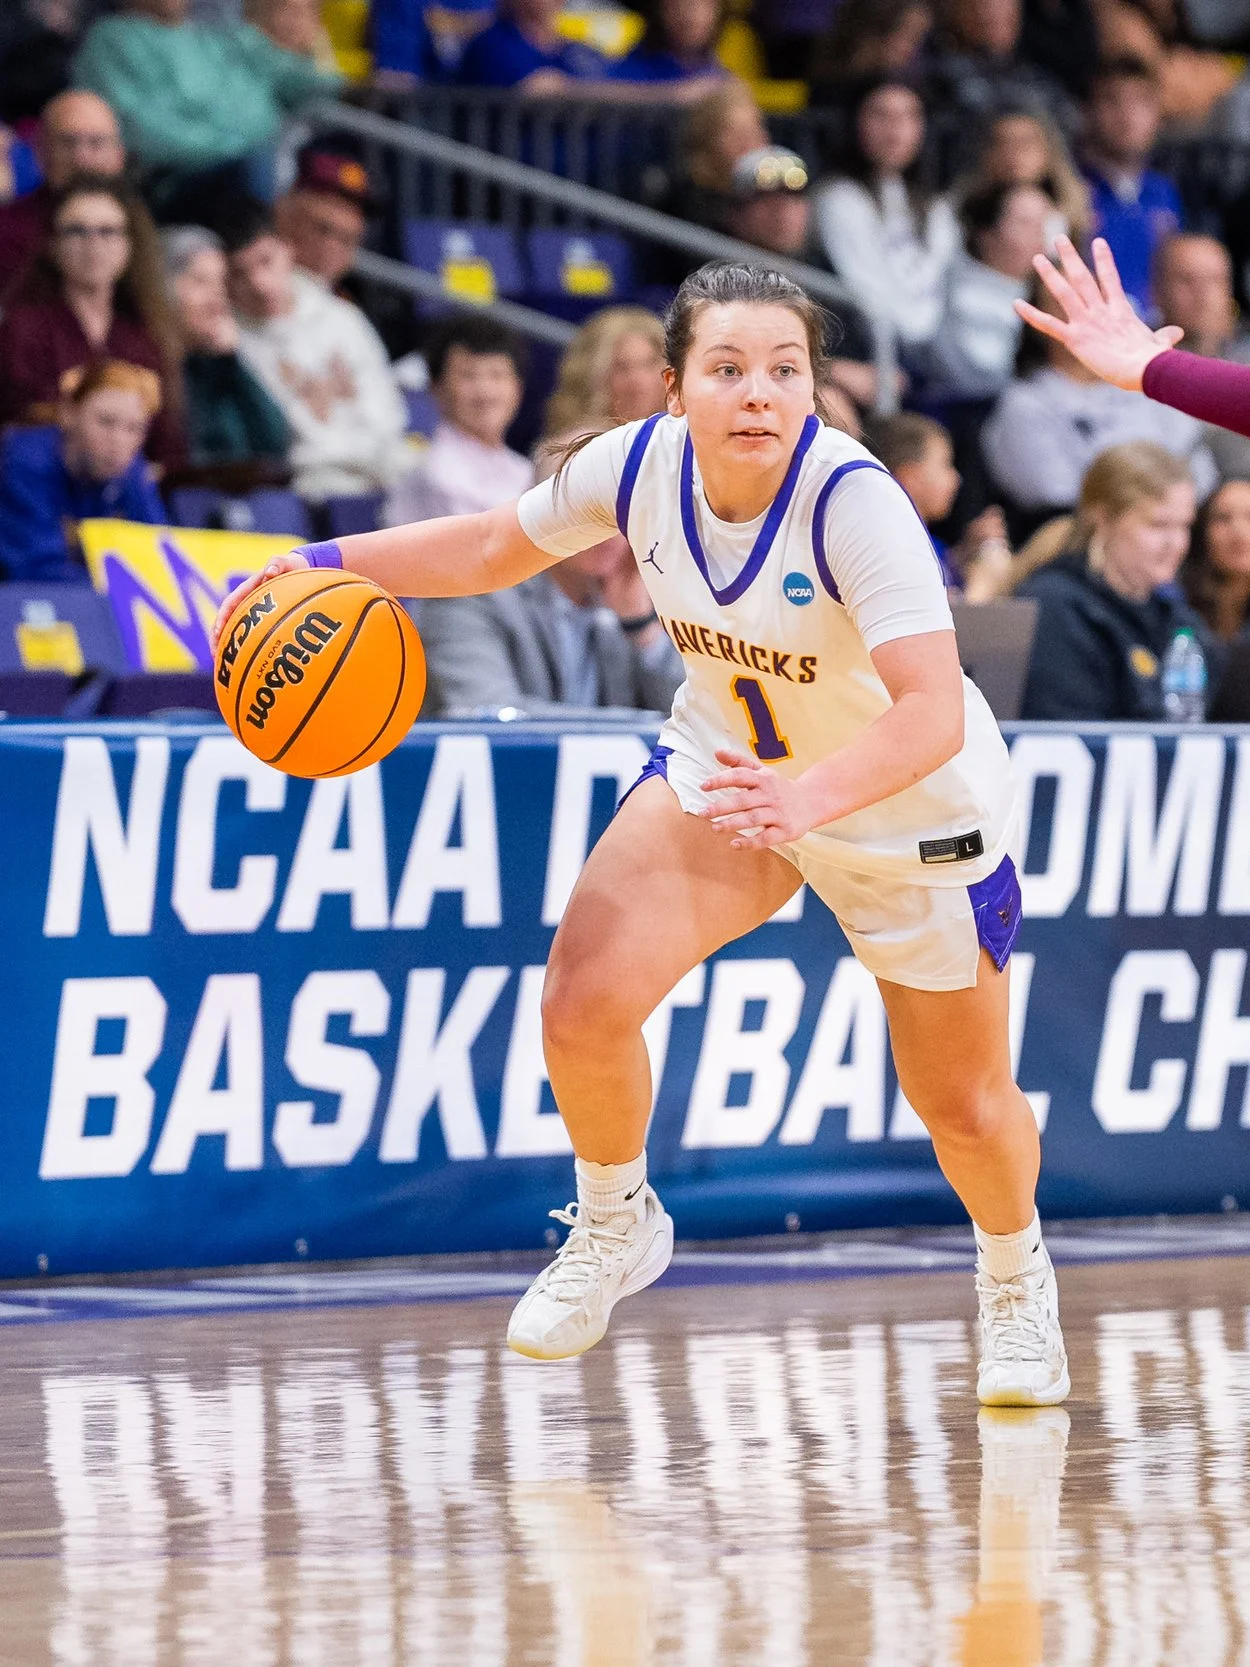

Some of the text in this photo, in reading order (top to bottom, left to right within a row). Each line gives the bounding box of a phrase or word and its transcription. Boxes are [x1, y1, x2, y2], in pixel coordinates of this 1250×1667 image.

[786, 588, 813, 598] NCAA
[217, 592, 277, 689] NCAA
[246, 611, 343, 729] Wilson
[256, 639, 282, 680] EVO NXT
[660, 615, 818, 685] AVERICKS
[729, 674, 794, 764] 1
[42, 735, 503, 938] NCAA
[966, 841, 974, 852] L
